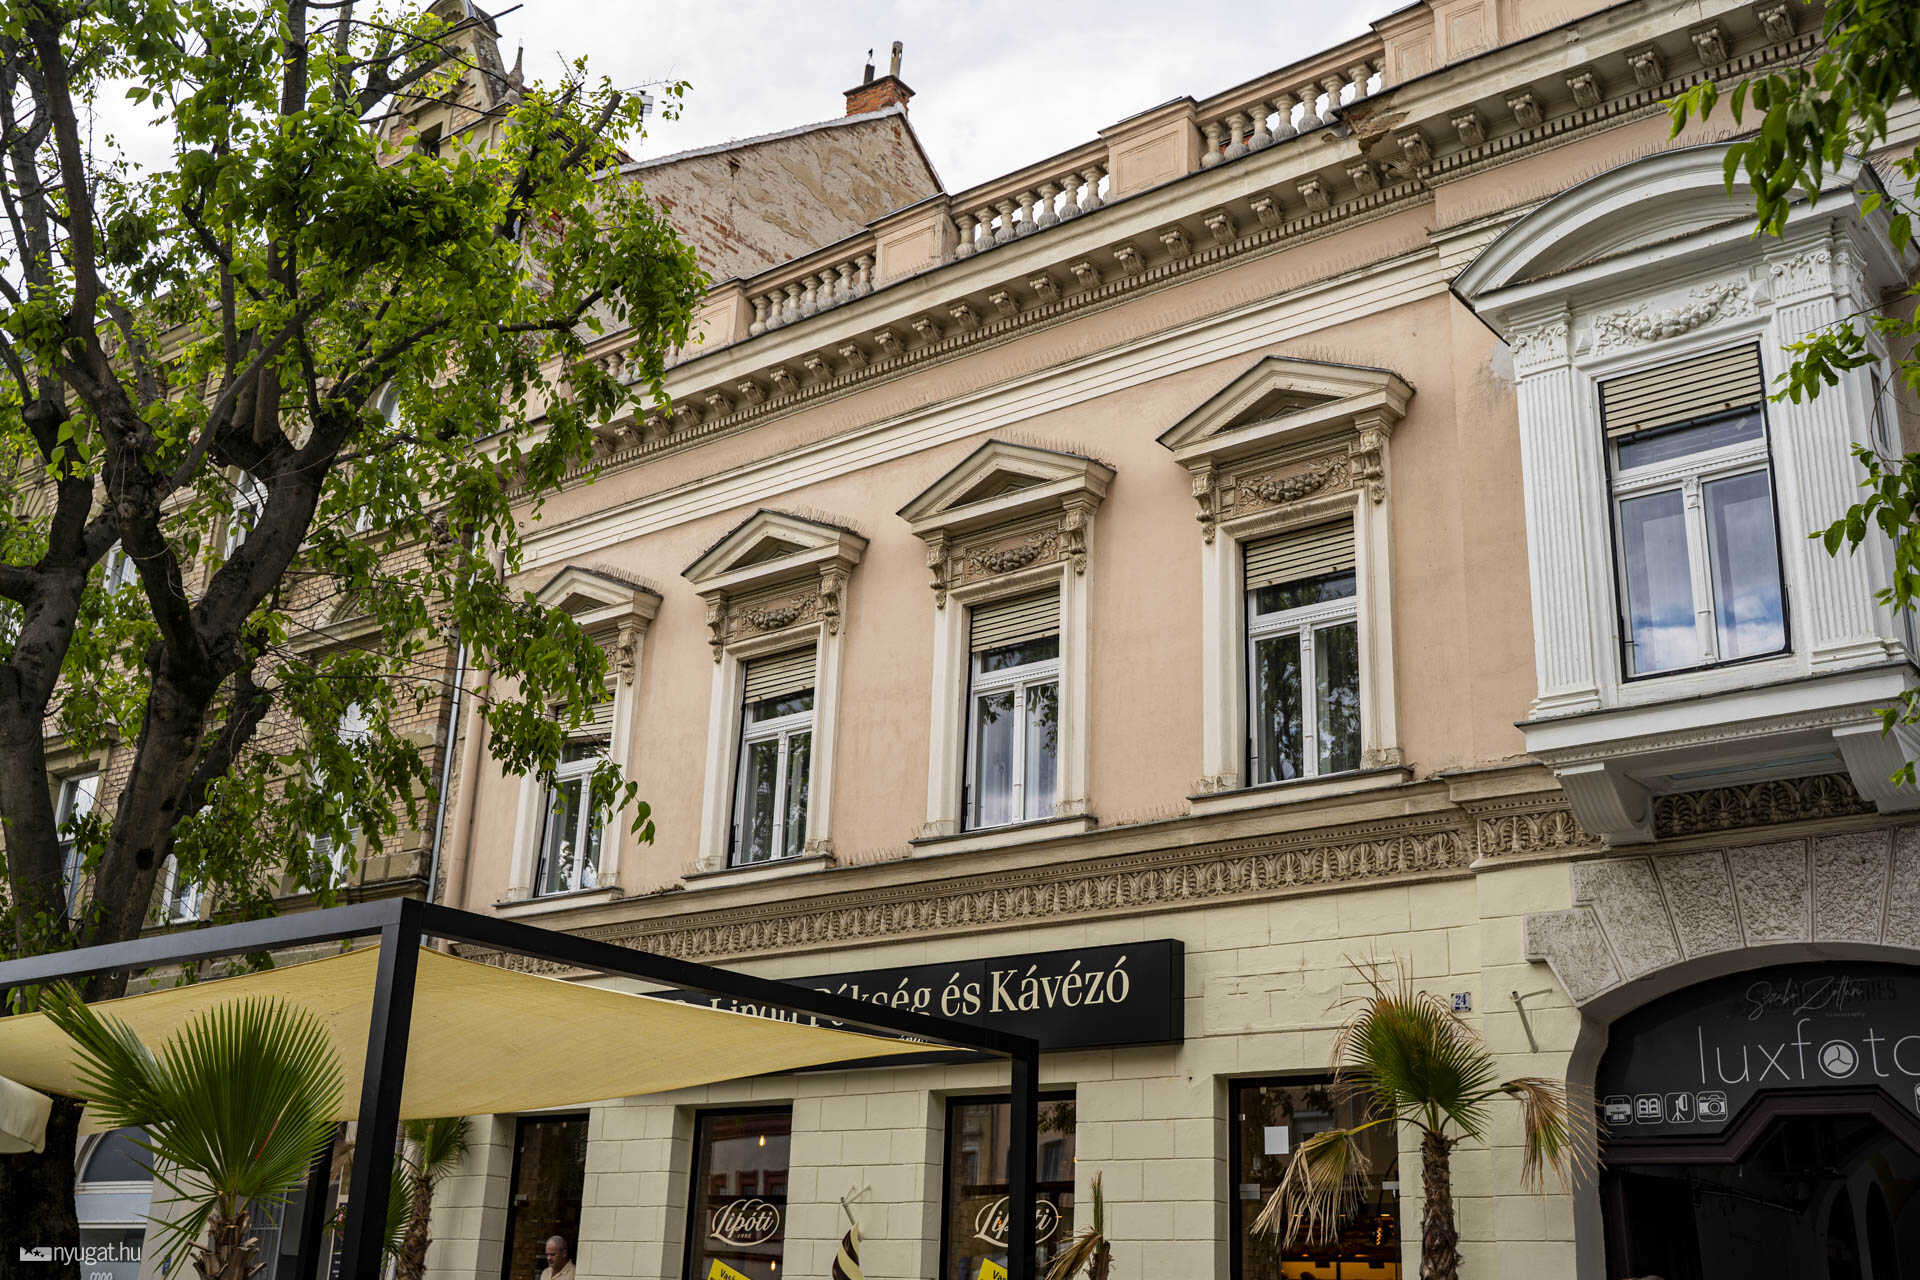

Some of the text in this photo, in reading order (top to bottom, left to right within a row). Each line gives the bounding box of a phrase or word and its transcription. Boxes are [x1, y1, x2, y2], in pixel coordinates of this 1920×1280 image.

[941, 971, 982, 1017] és
[989, 955, 1130, 1013] Kávézó
[711, 1199, 776, 1244] Lipóti
